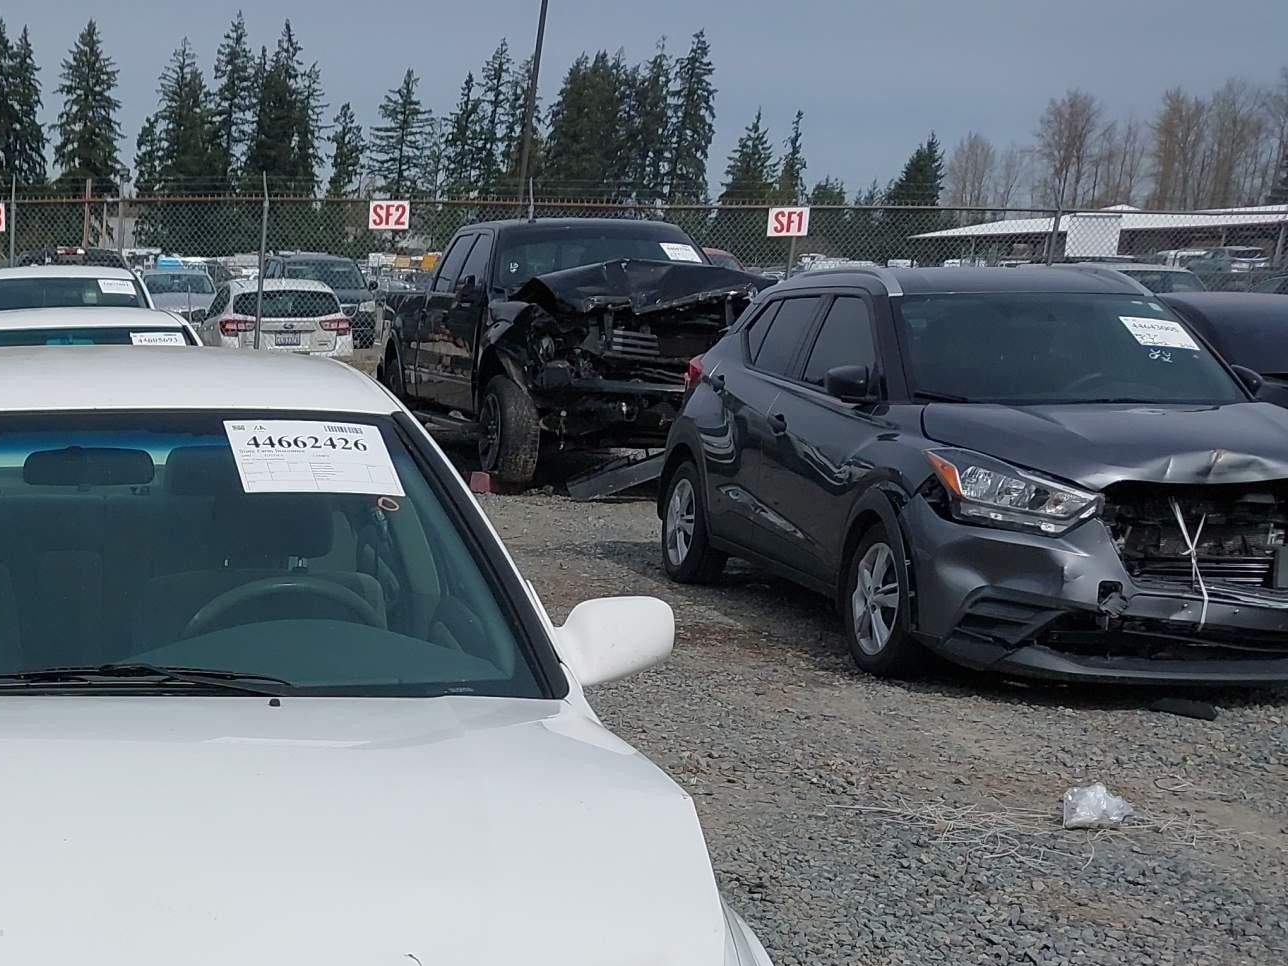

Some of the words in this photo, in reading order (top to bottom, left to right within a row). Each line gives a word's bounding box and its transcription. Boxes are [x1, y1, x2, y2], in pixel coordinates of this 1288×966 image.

[372, 204, 407, 226] SF2
[773, 210, 804, 233] SF1
[246, 435, 368, 452] 44662426
